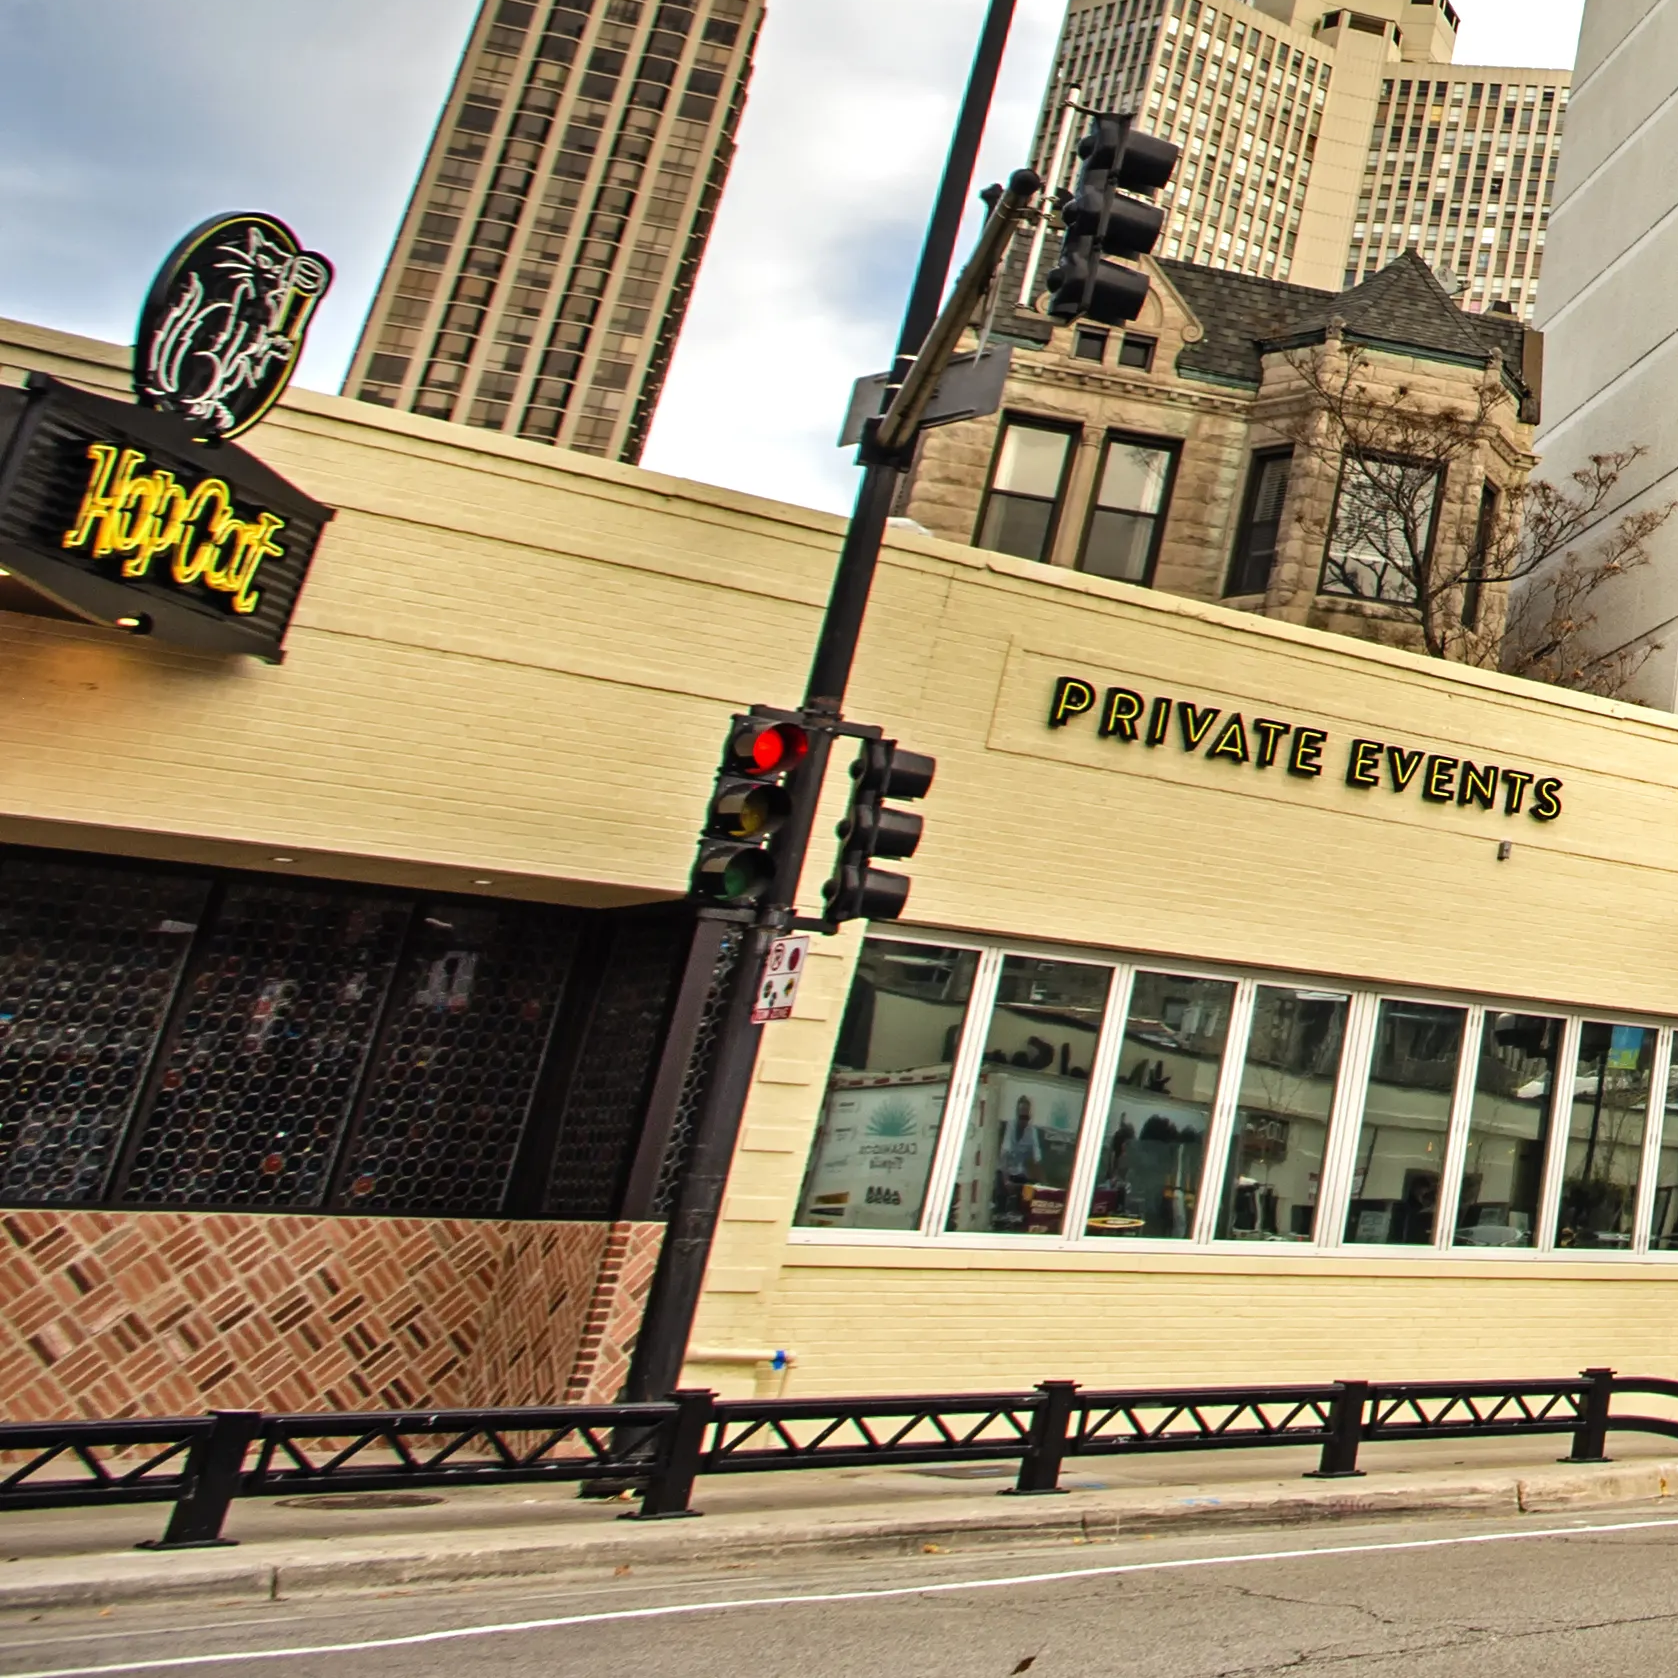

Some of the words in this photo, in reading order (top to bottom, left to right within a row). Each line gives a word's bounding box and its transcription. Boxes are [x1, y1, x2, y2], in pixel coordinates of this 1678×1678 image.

[64, 444, 284, 613] HopCat
[1048, 676, 1328, 778] PRIVATE
[1346, 738, 1563, 821] EVENTS
